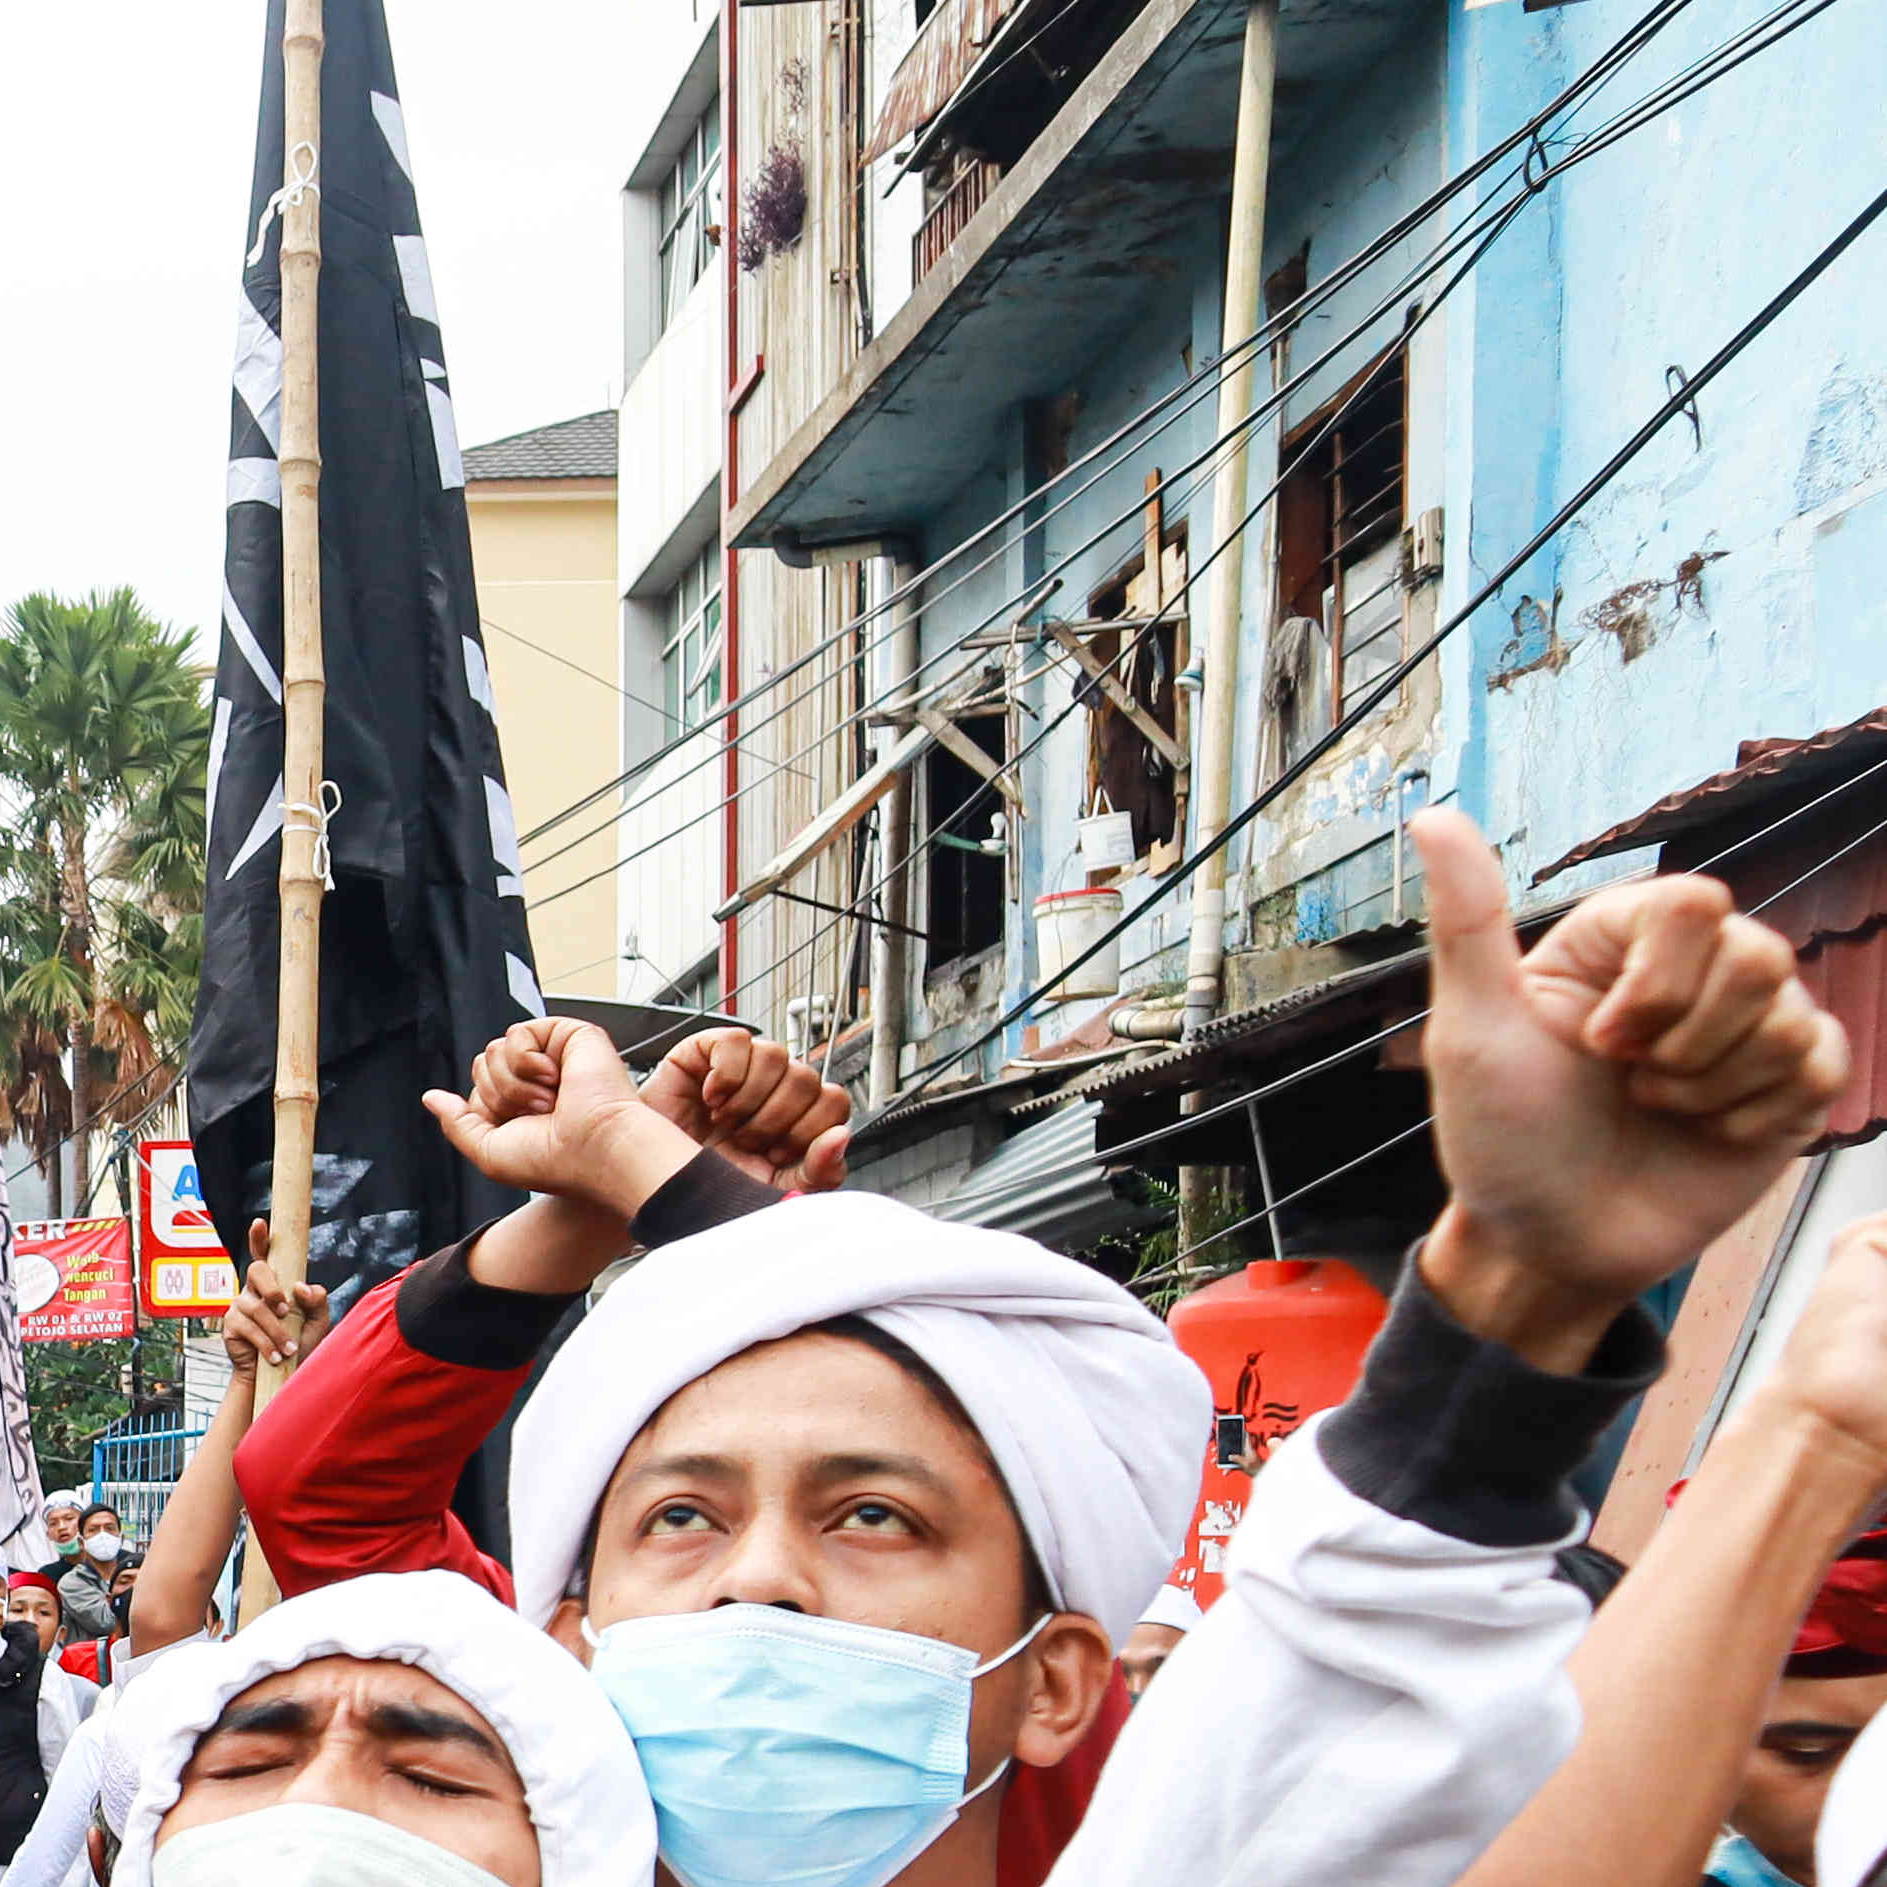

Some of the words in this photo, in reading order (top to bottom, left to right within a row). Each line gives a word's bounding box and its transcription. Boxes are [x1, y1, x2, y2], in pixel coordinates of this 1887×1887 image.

[63, 1287, 108, 1304] Tangan
[27, 1314, 49, 1326] RW
[84, 1312, 104, 1323] RW
[107, 1311, 123, 1322] 02
[69, 1323, 124, 1335] SELATAN
